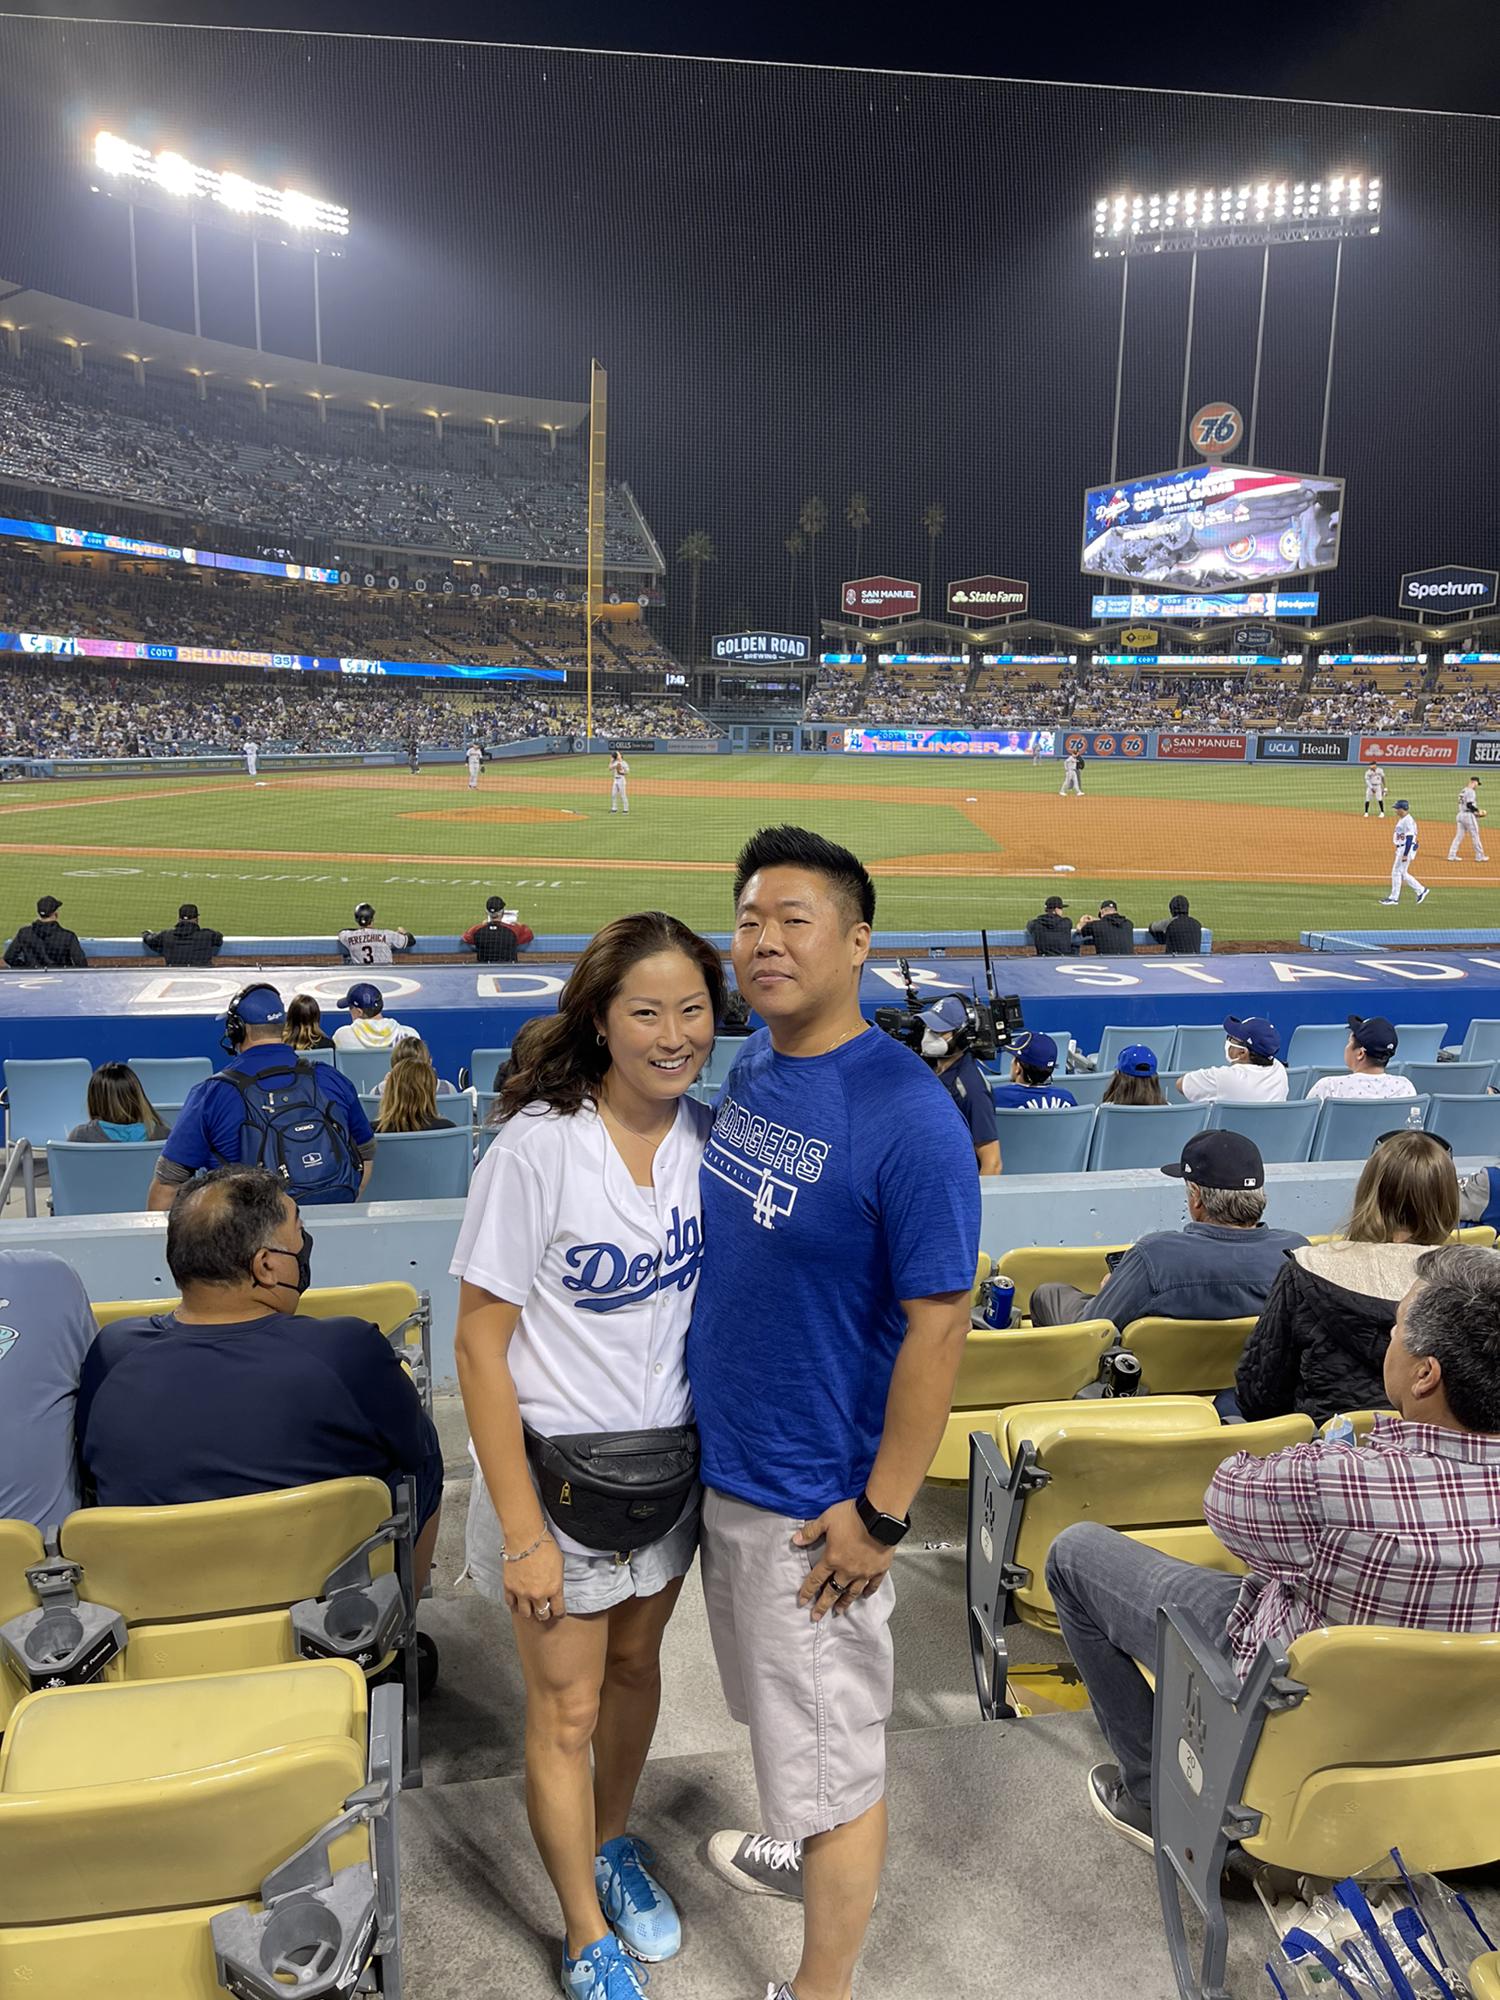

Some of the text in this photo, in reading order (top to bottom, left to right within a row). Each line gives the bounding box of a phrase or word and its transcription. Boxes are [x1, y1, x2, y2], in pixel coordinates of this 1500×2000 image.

[1196, 411, 1236, 444] 76
[861, 590, 917, 599] SAN MANUEL
[1408, 581, 1484, 600] Spectrum
[717, 636, 805, 657] GOLDEN ROAD
[150, 648, 291, 667] CODY BELLINGER 35
[876, 741, 1000, 753] BELLINGER
[1070, 738, 1084, 749] 76
[1098, 739, 1111, 750] 76
[1126, 739, 1140, 750] 76
[1173, 738, 1243, 748] SAN MANUEL
[1269, 743, 1295, 753] UCLA
[1301, 742, 1341, 755] Health
[362, 945, 374, 964] 3
[752, 1167, 776, 1230] LA
[562, 1206, 703, 1294] Dodg
